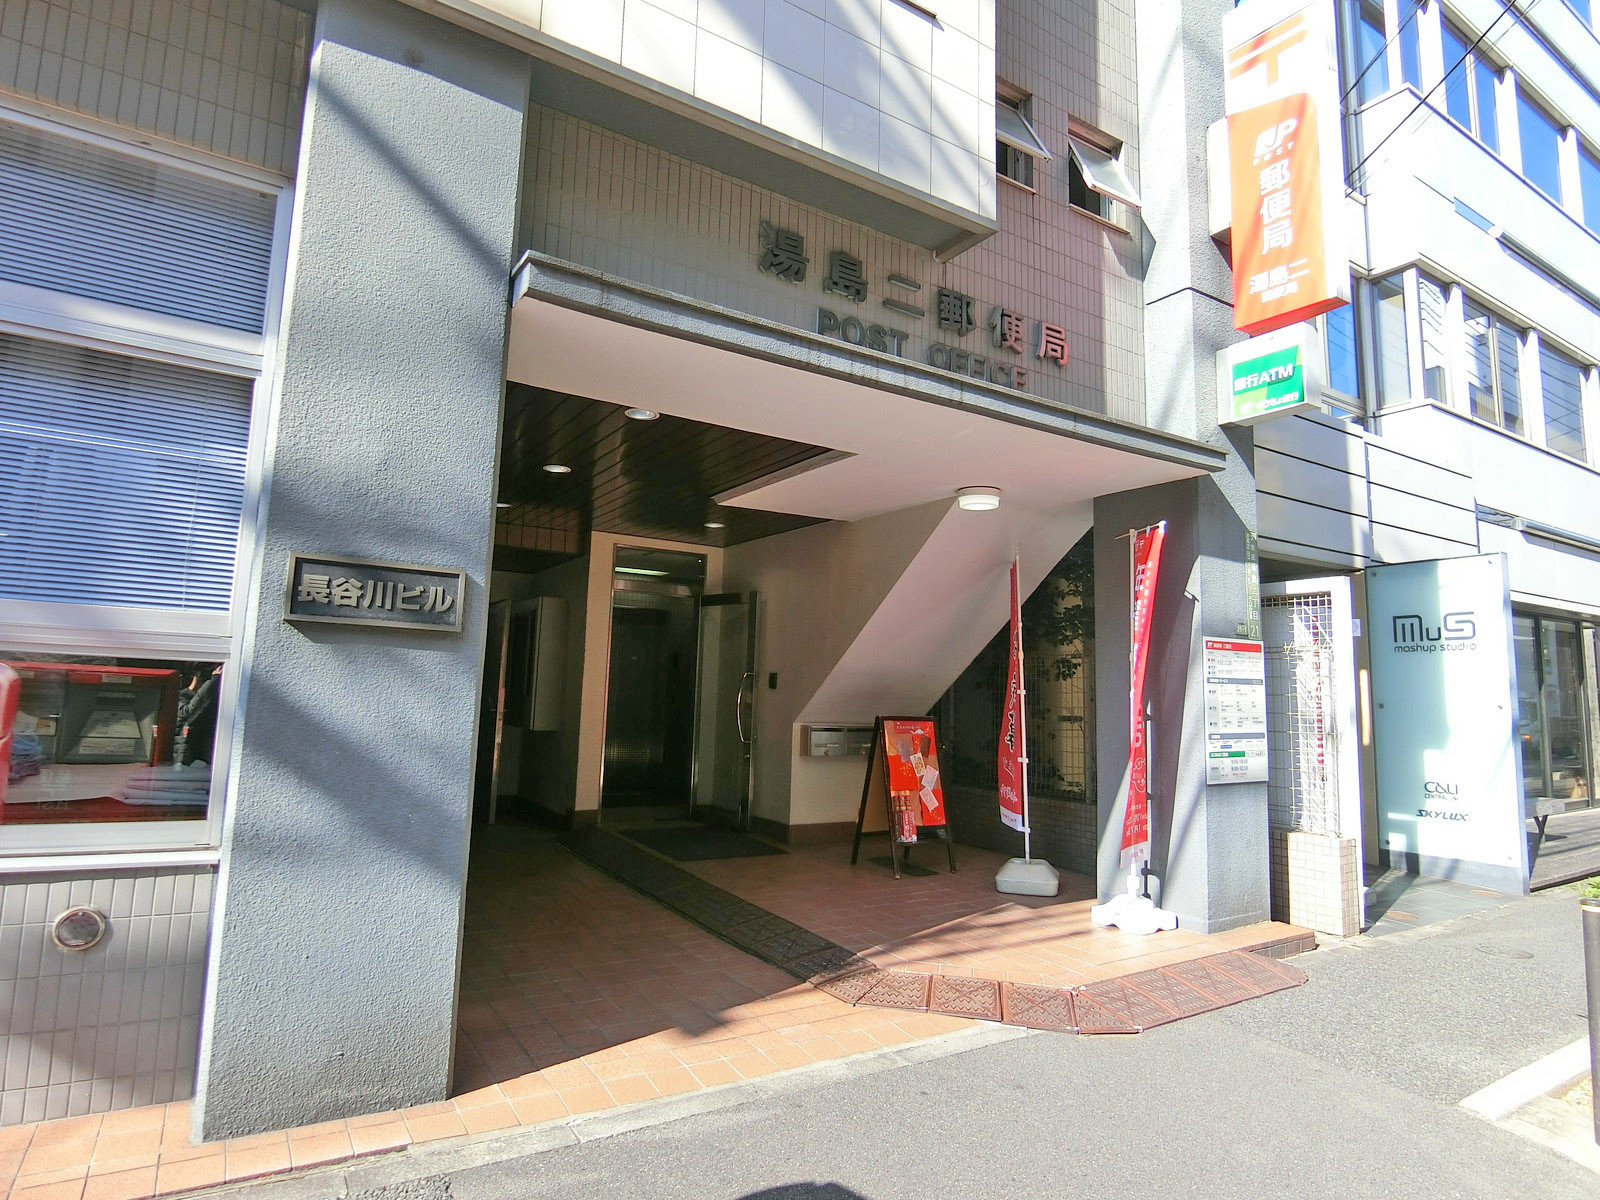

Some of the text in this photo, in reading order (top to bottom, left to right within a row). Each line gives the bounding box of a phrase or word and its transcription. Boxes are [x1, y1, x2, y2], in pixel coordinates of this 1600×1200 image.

[1259, 157, 1292, 256] 郵便局
[758, 219, 1069, 367] 湯島二郵便局
[816, 307, 1028, 389] POST OFFICE
[298, 573, 453, 613] 長谷川ビル
[1250, 624, 1260, 638] 21
[1394, 640, 1477, 654] mashup studio
[1416, 808, 1469, 822] SKYLUX
